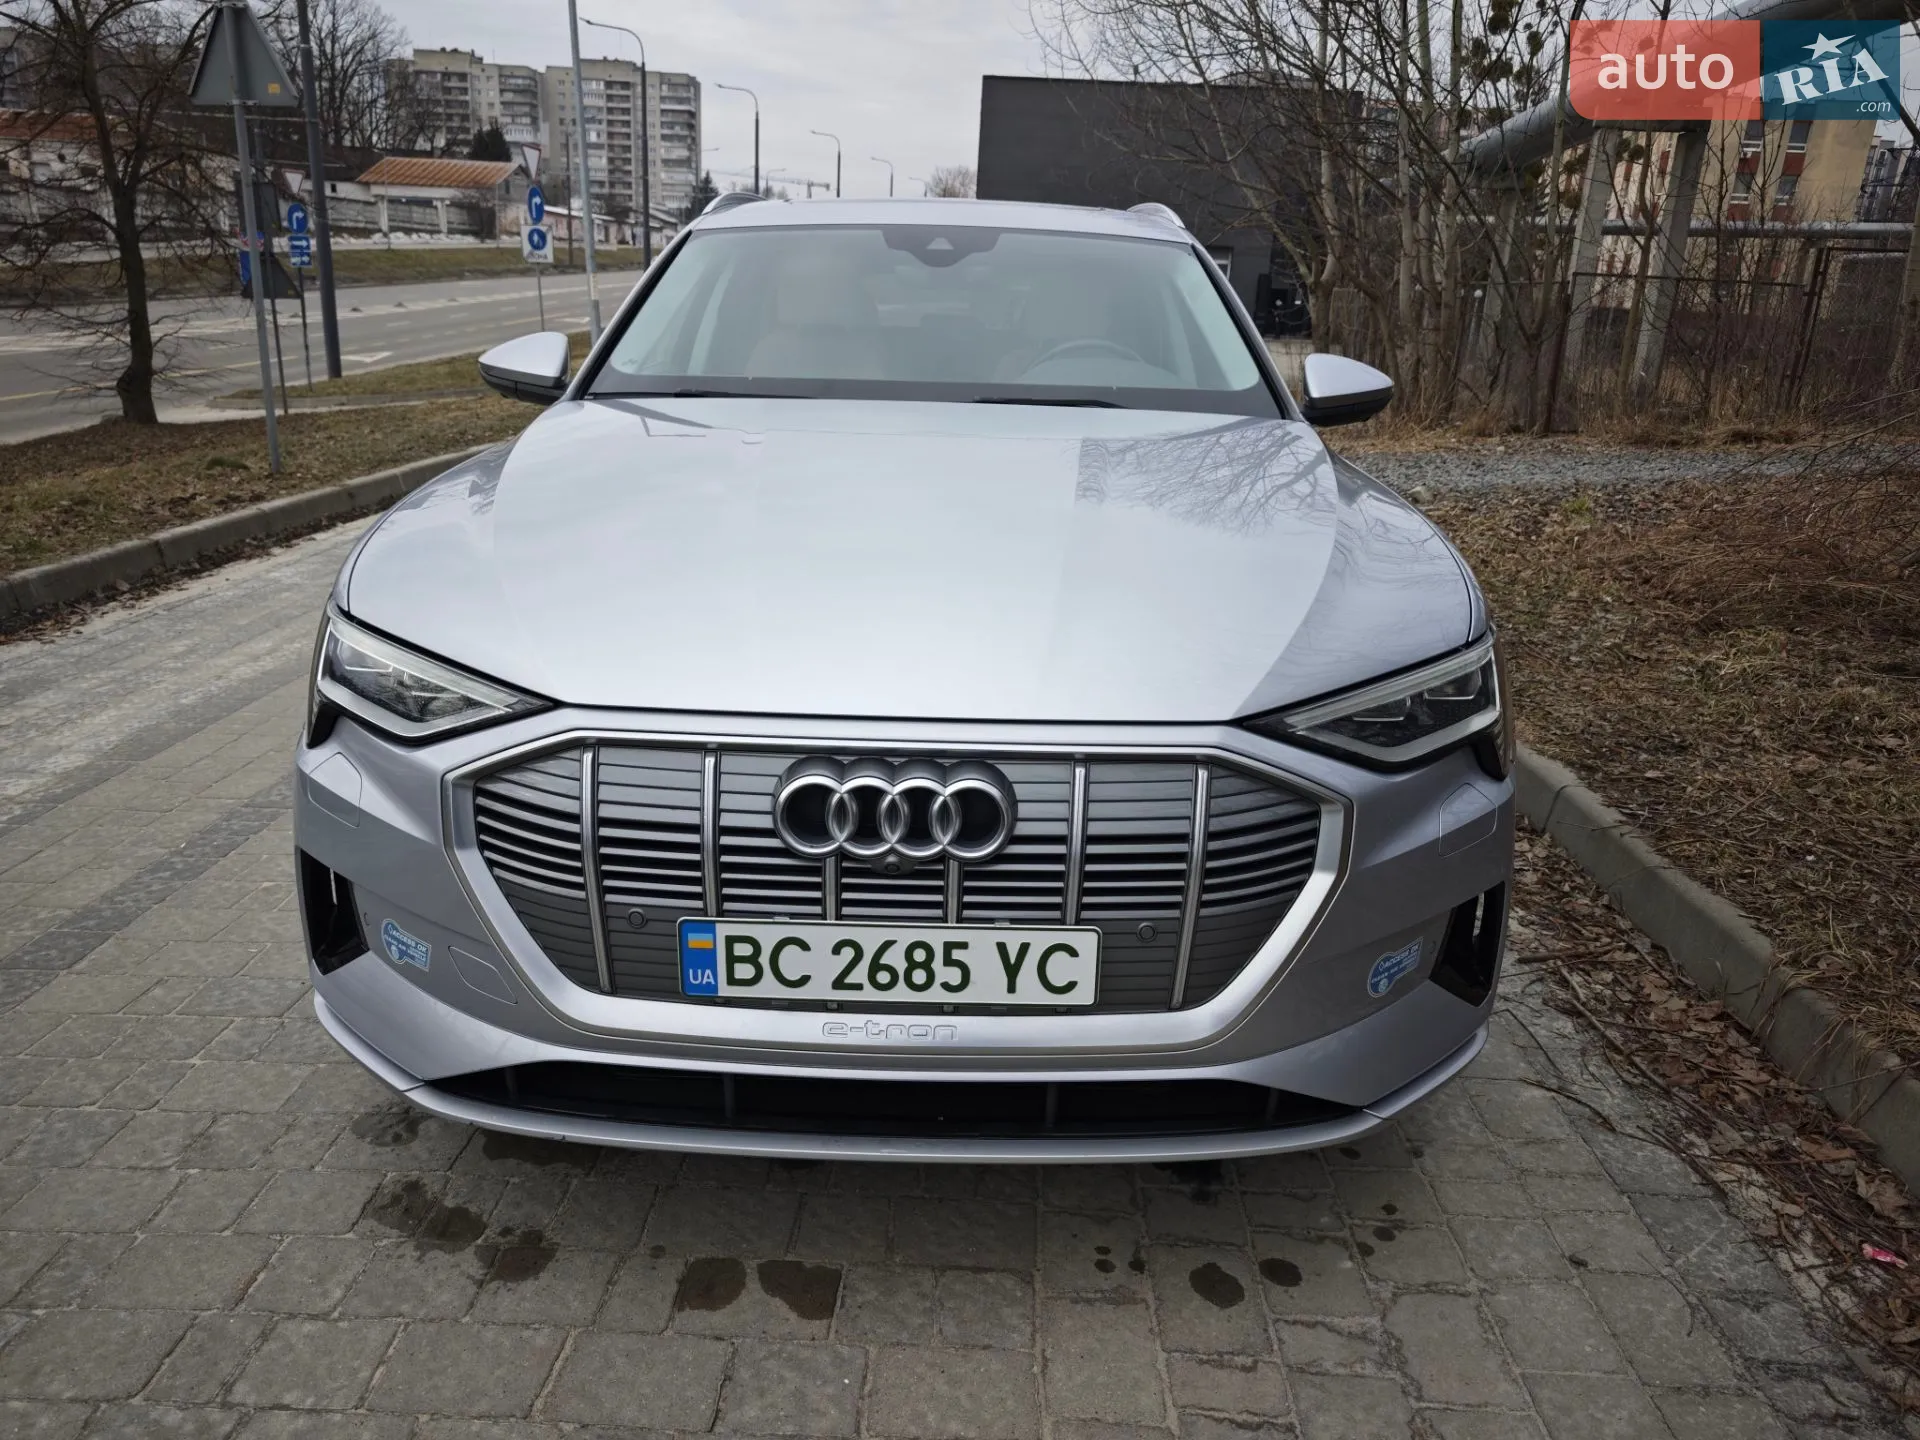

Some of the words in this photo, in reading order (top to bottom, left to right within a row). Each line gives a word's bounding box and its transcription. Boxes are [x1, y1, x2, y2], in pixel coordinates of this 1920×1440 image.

[724, 935, 812, 989] BC
[831, 938, 971, 993] 2685
[996, 941, 1080, 995] YC
[689, 968, 716, 985] UA
[822, 1019, 958, 1041] e-tron
